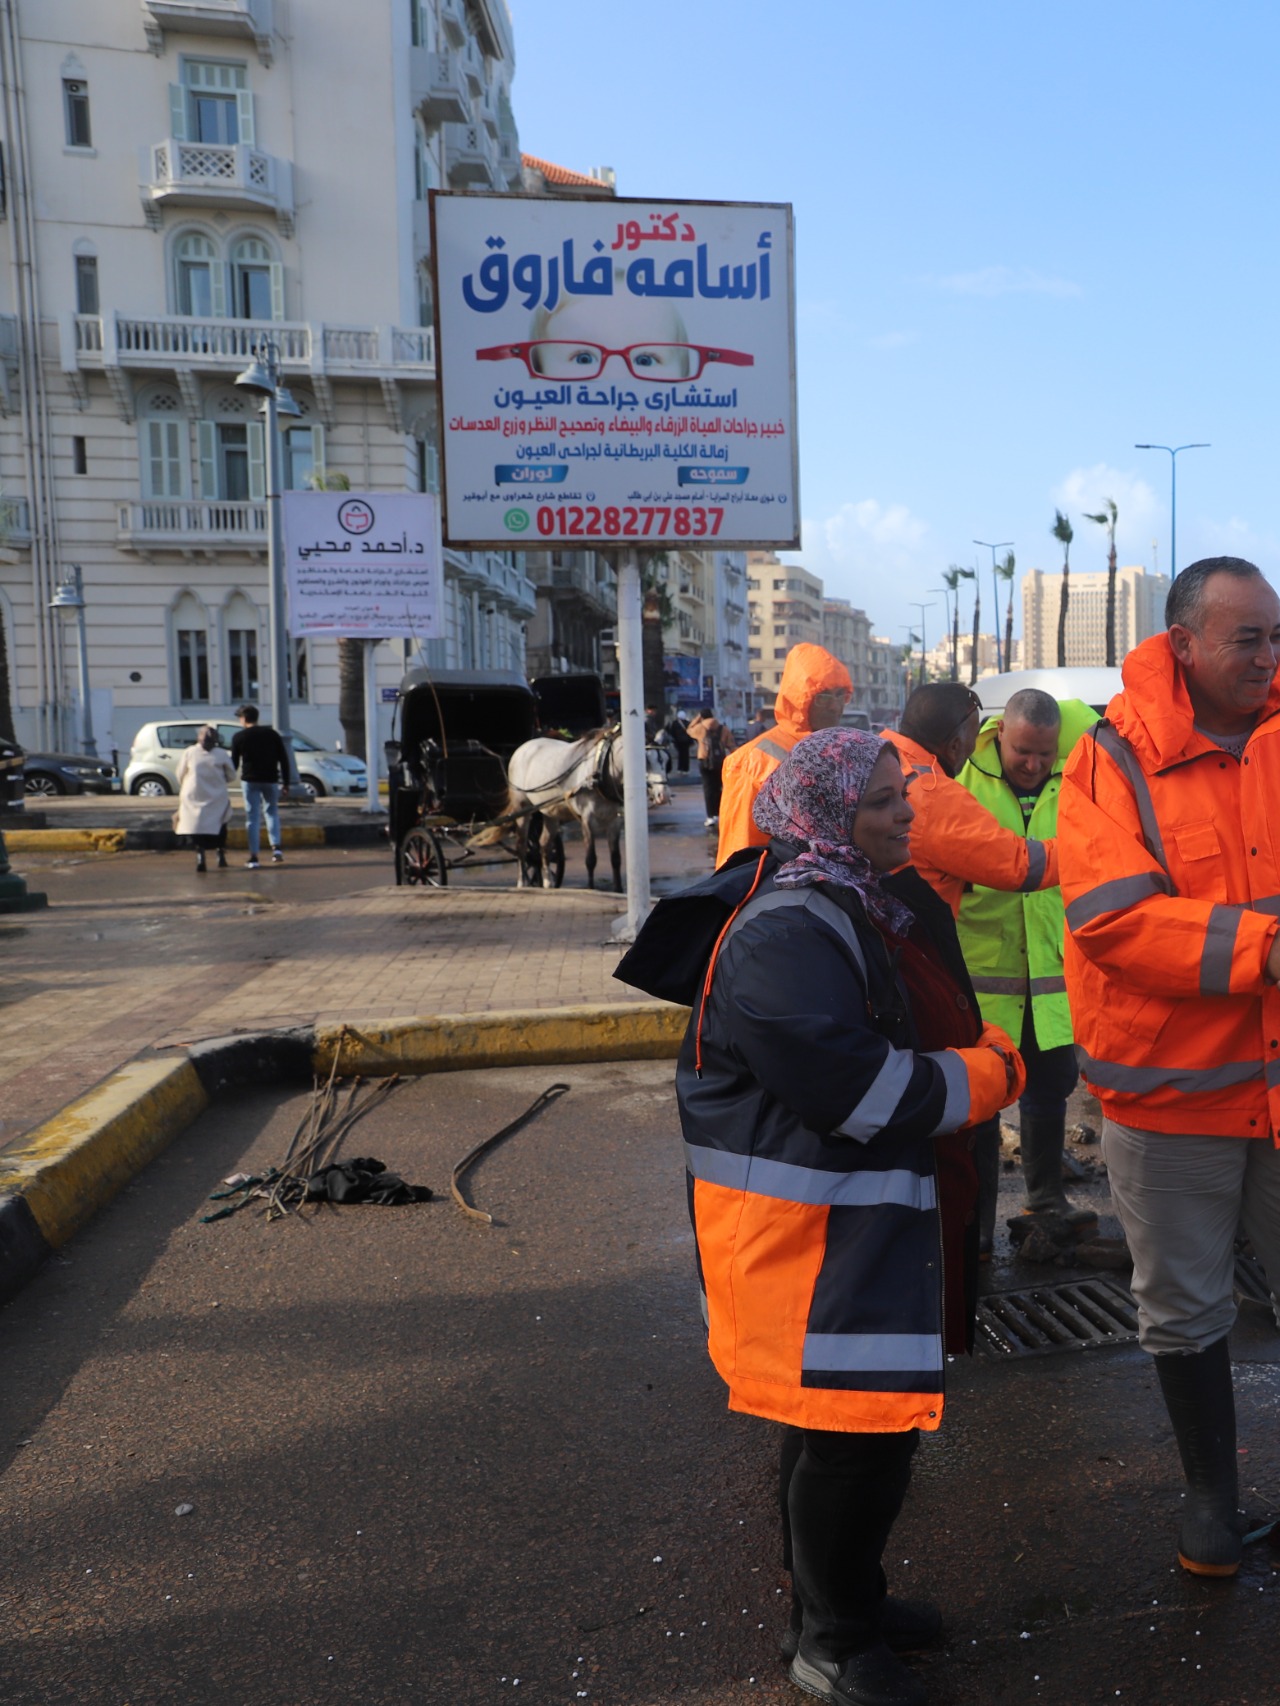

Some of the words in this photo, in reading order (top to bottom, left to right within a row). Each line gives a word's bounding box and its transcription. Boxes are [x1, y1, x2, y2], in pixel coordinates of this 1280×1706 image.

[612, 212, 696, 250] دكتور
[462, 235, 613, 314] فاروق
[626, 231, 772, 300] أسامه
[494, 384, 571, 410] العيون
[576, 384, 639, 411] جراحة
[449, 415, 501, 432] العدسات
[502, 417, 526, 438] وزرع
[528, 416, 557, 436] النظر
[559, 417, 605, 438] وتصحيح
[608, 415, 652, 437] والبيضاء
[655, 416, 688, 437] الزرقاء
[723, 417, 758, 438] جراحات
[760, 418, 785, 438] خبير
[516, 442, 556, 460] العيون
[604, 443, 660, 462] البريطانية
[663, 443, 697, 462] الكلية
[700, 443, 729, 462] زمالة
[511, 466, 553, 482] لوران
[489, 493, 501, 503] مع
[535, 491, 556, 503] شارع
[557, 491, 582, 502] تقاطع
[537, 506, 724, 536] 01228277837
[298, 541, 352, 561] محيي
